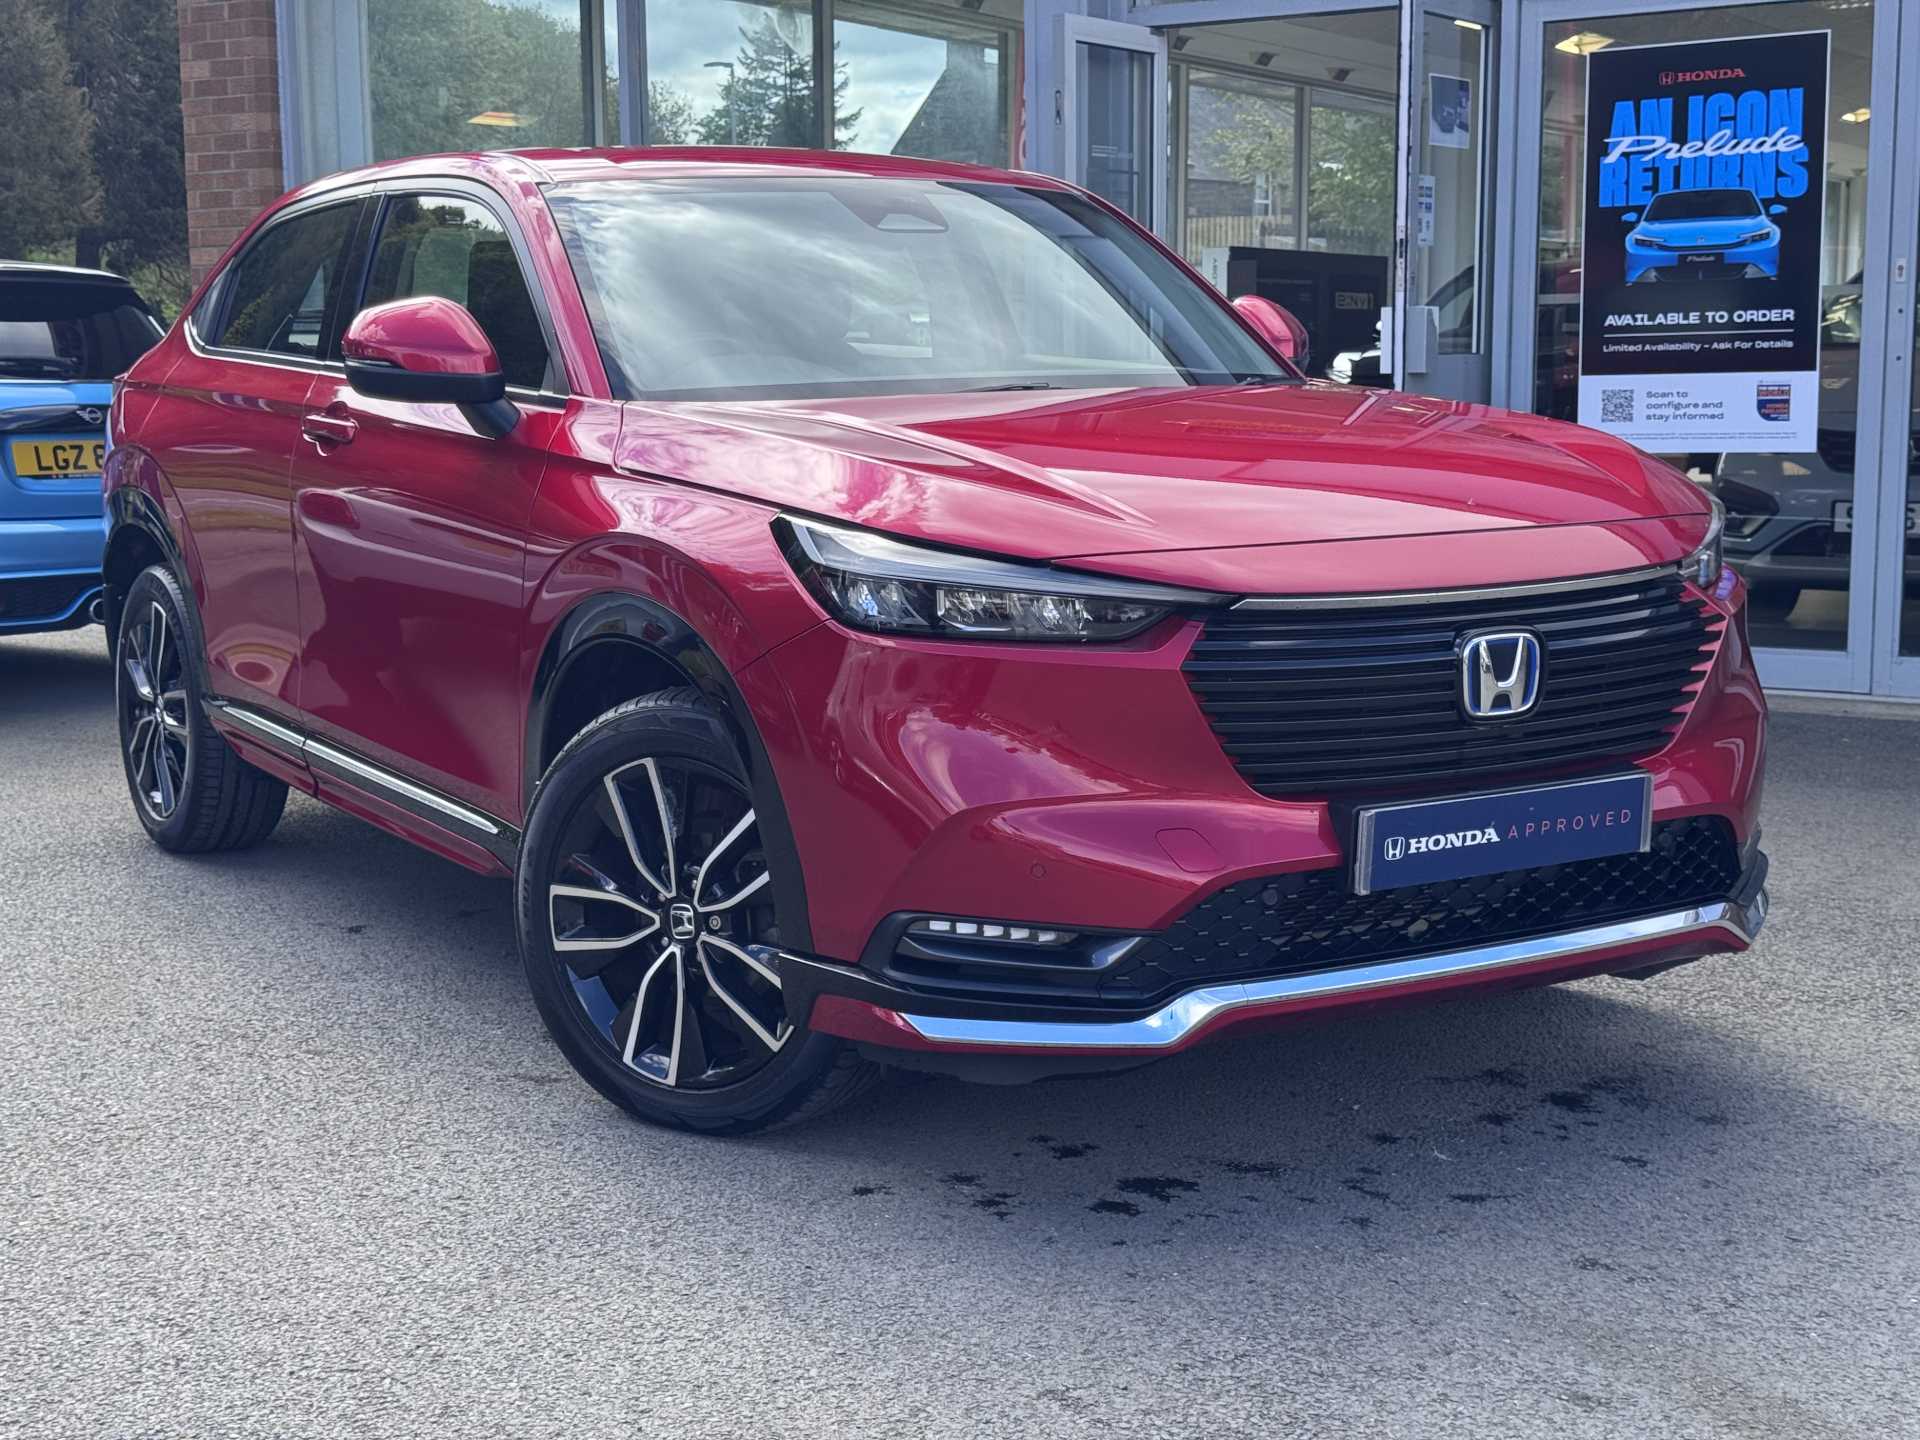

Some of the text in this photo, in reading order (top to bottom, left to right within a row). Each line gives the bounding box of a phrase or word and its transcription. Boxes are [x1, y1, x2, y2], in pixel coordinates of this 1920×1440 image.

[1676, 67, 1746, 83] HONDA
[1608, 87, 1804, 152] AN ICON
[1603, 126, 1805, 164] Prelude
[1598, 146, 1809, 208] RETURNS
[1604, 308, 1795, 327] AVAILABLE TO ORDER
[1602, 343, 1643, 353] Limited
[1644, 342, 1702, 352] Availability
[1711, 341, 1732, 350] Ask
[1734, 340, 1753, 349] For
[1755, 339, 1794, 348] Details
[1645, 390, 1675, 399] Scan
[1645, 400, 1723, 411] configure and
[1645, 411, 1725, 423] stay informed
[33, 444, 88, 471] LGZ
[1407, 827, 1501, 854] HONDA
[1507, 808, 1632, 840] APPROVED
